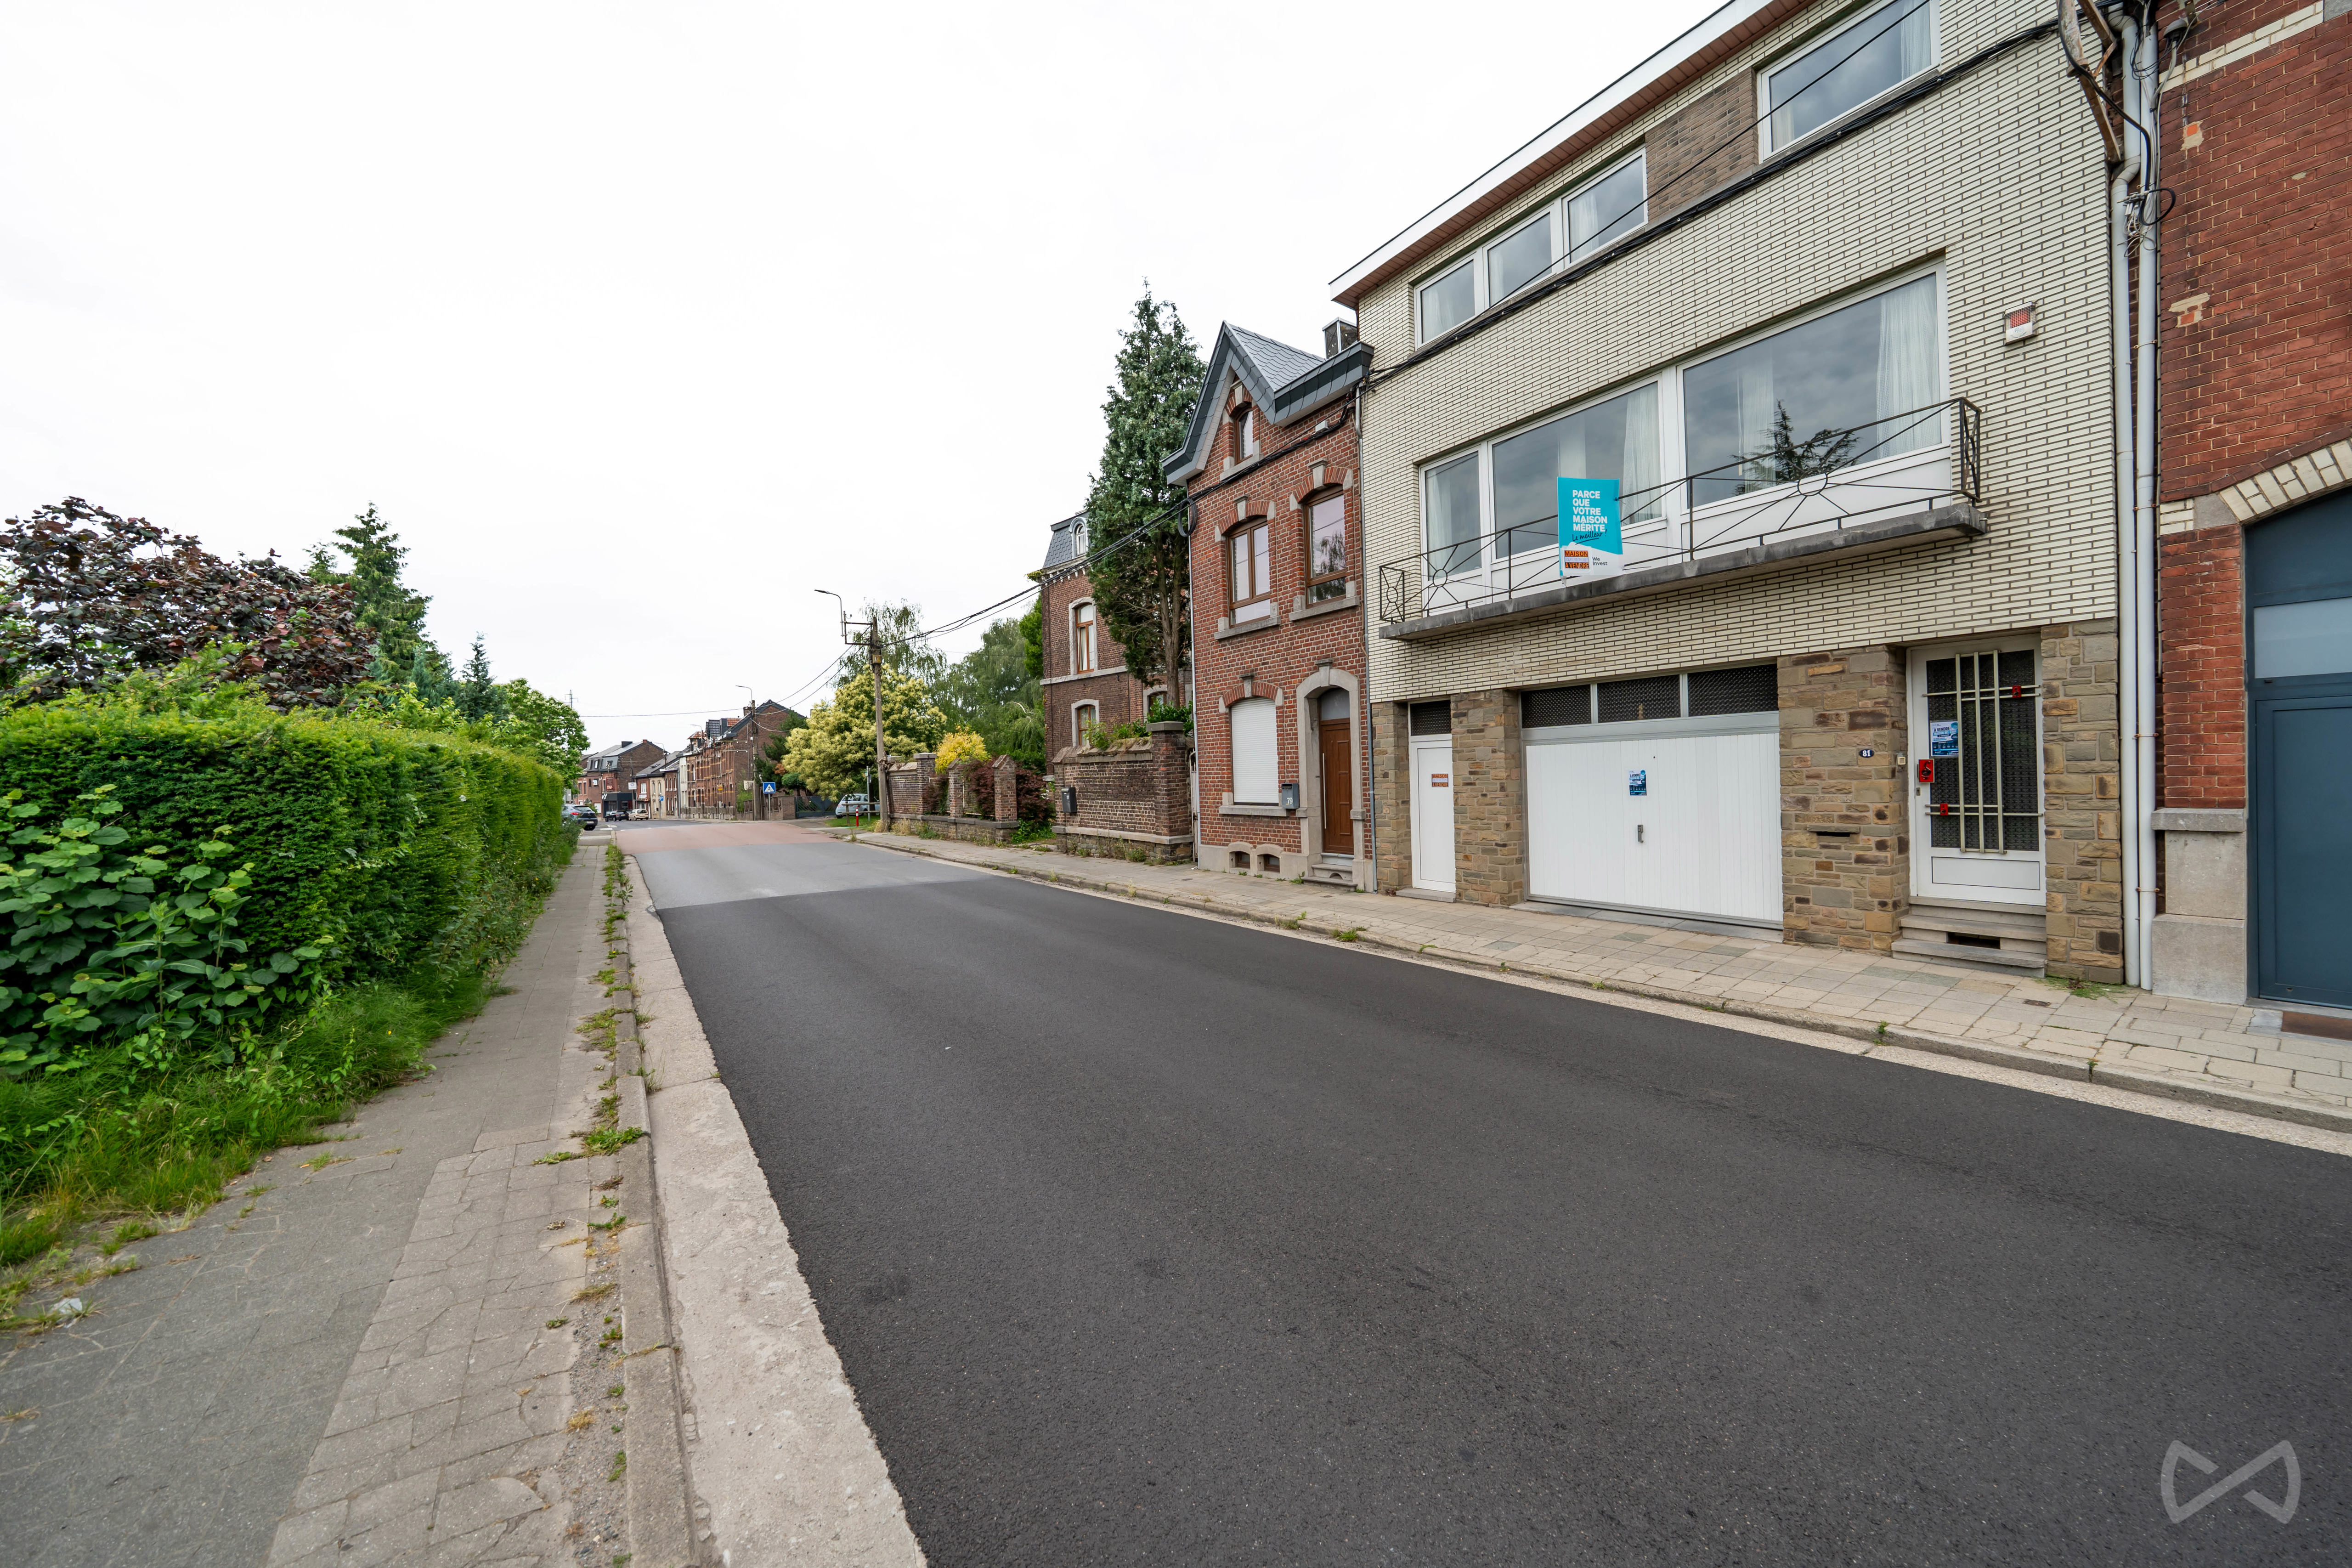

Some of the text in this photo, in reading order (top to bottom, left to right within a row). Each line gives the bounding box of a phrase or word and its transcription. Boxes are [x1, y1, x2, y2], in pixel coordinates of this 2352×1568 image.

[1572, 490, 1600, 499] PARCE
[1572, 498, 1590, 507] QUE
[1573, 507, 1601, 515] VOTRE
[1573, 515, 1607, 524] MAISON
[1573, 522, 1605, 532] MÉRITE
[1579, 531, 1603, 539] meilleur
